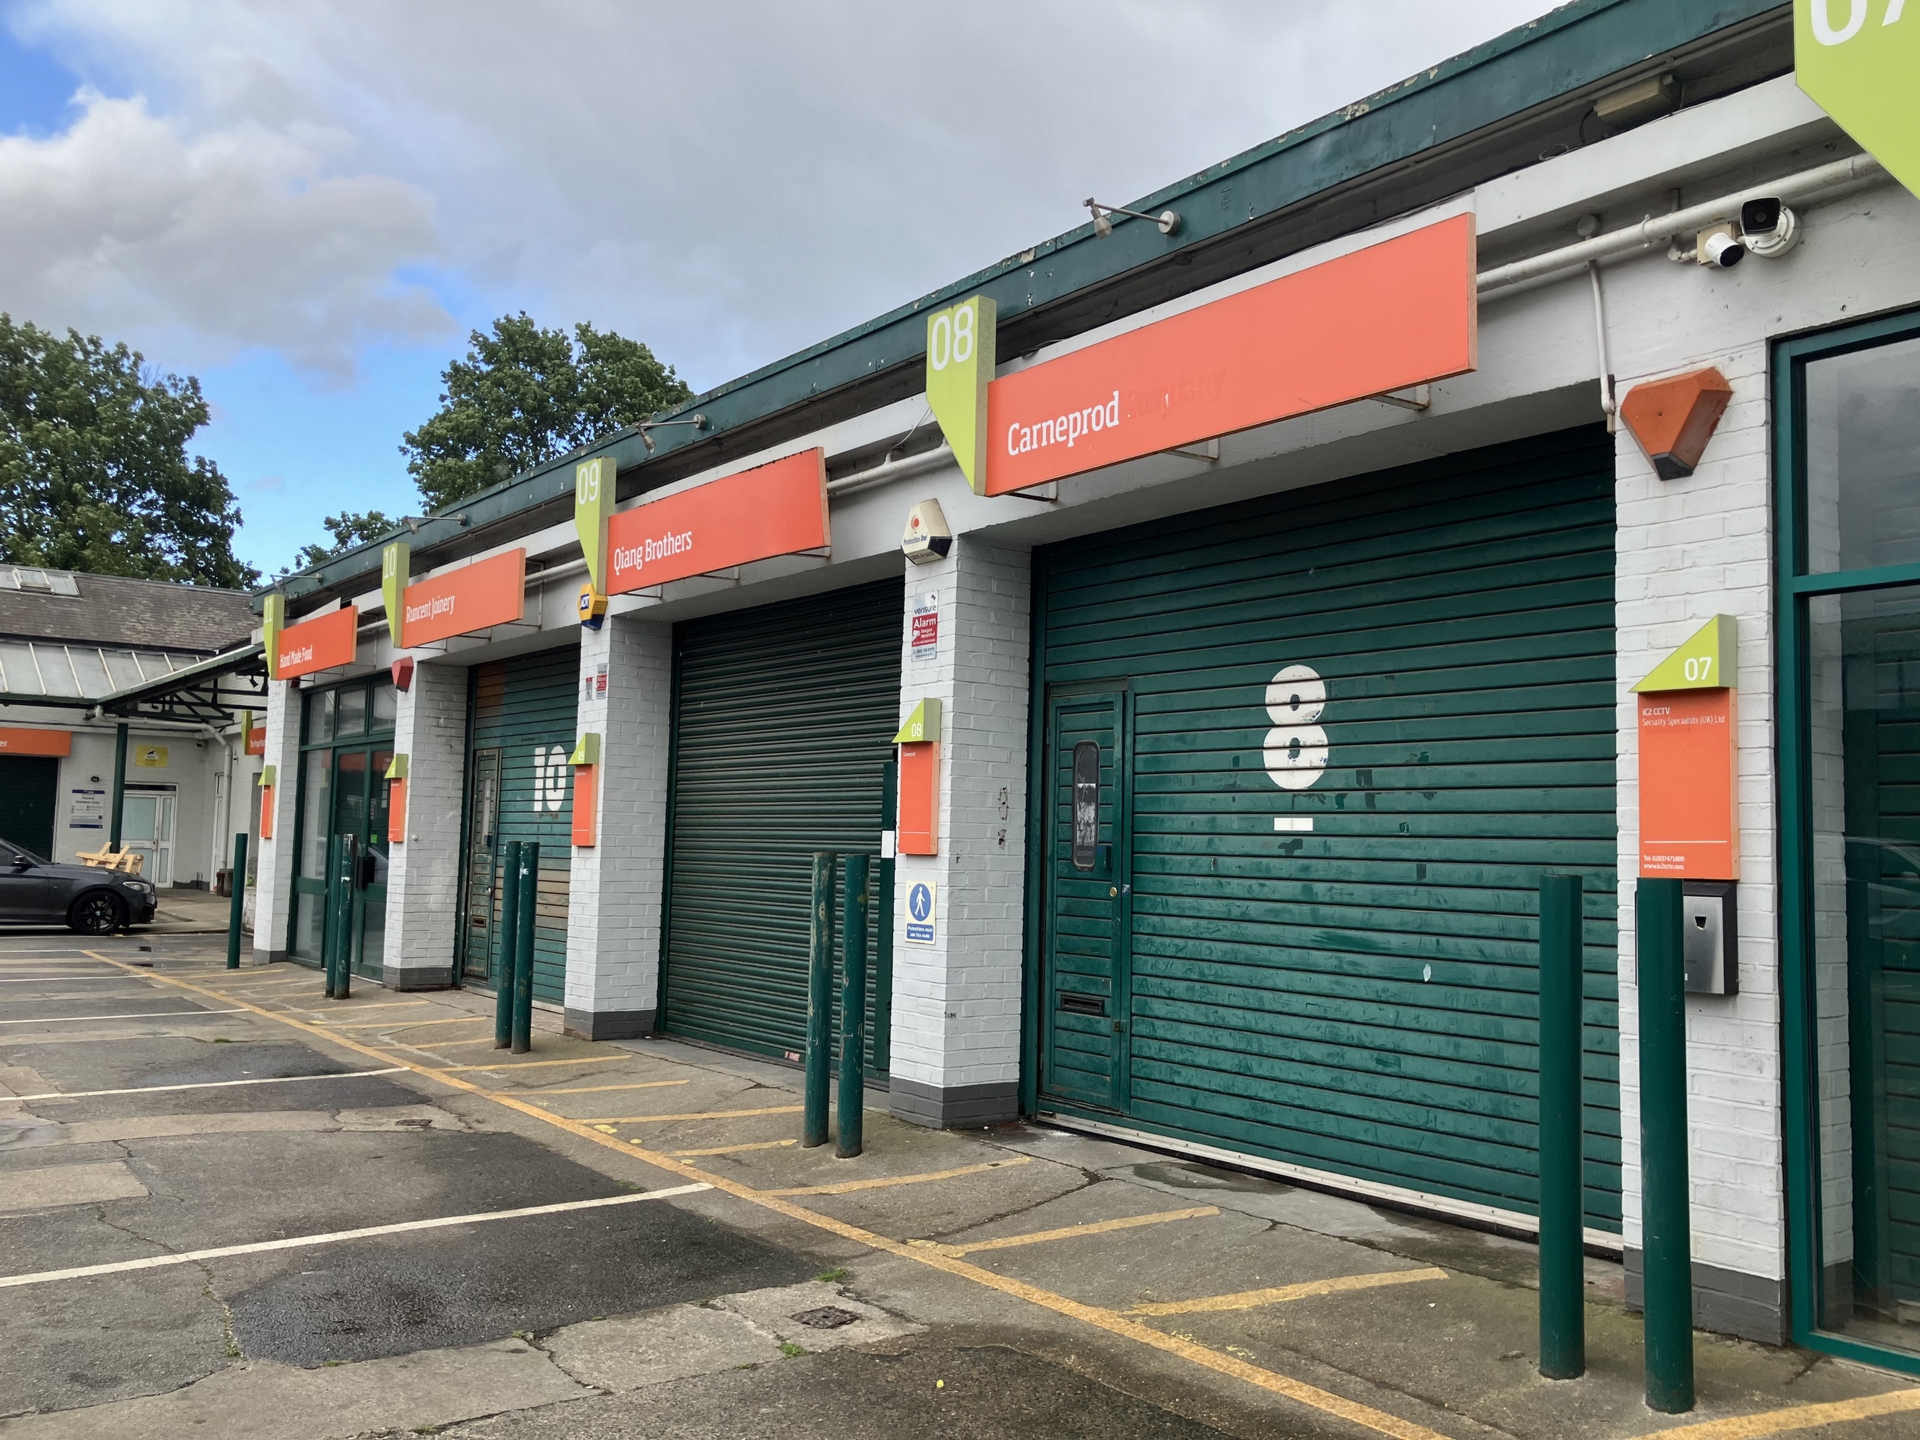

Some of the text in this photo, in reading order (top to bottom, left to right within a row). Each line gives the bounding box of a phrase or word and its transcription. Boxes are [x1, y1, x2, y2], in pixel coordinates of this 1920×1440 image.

[931, 306, 974, 371] 08
[1007, 390, 1120, 456] Carneprod
[578, 462, 599, 505] 09
[383, 547, 396, 579] 10
[613, 531, 692, 576] Qiang Brothers
[263, 598, 273, 624] 11
[405, 595, 455, 623] Runcent Joinery
[914, 604, 936, 615] verisure
[913, 617, 936, 629] Alarm
[279, 644, 313, 668] Hand Made Food
[1684, 656, 1712, 681] 07
[1642, 715, 1725, 727] Security Specialists (UK) Ltd
[1653, 707, 1670, 715] CCTV
[911, 723, 922, 737] 08
[1263, 665, 1328, 789] 8
[578, 750, 585, 761] 09
[534, 745, 567, 812] 10
